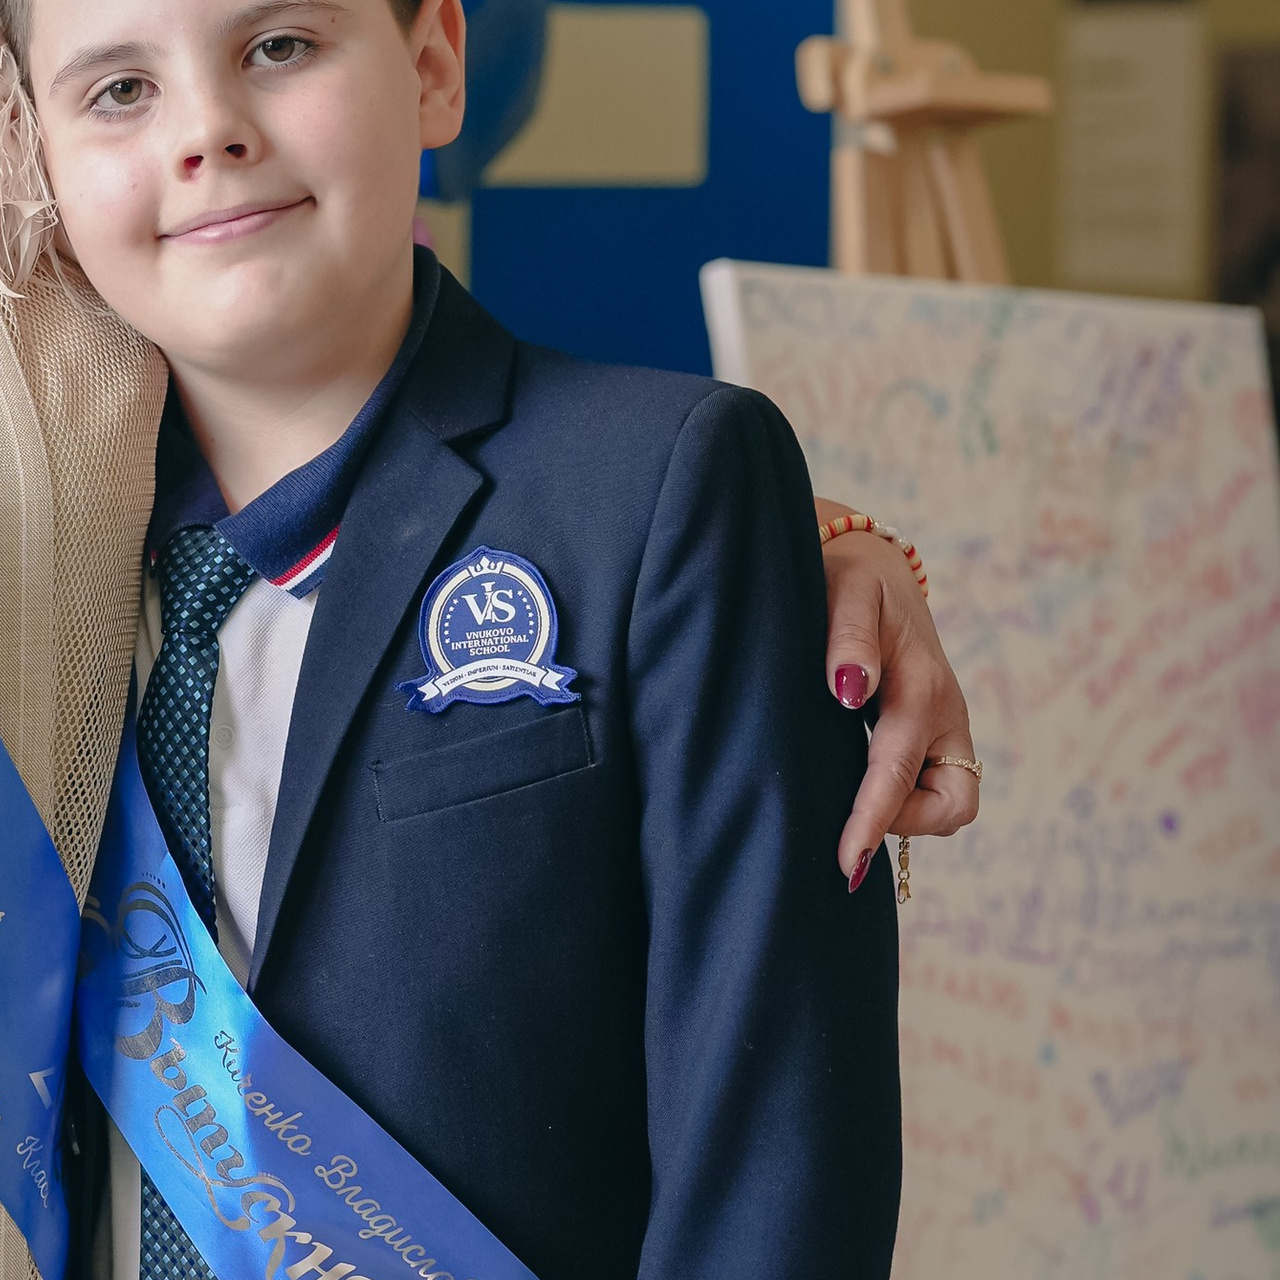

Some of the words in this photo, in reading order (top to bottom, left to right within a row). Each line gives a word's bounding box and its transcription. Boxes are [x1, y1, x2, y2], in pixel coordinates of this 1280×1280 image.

[466, 627, 514, 640] VNUKOVO
[451, 634, 529, 651] INTERNATIONAL
[469, 644, 511, 656] SCHOOL
